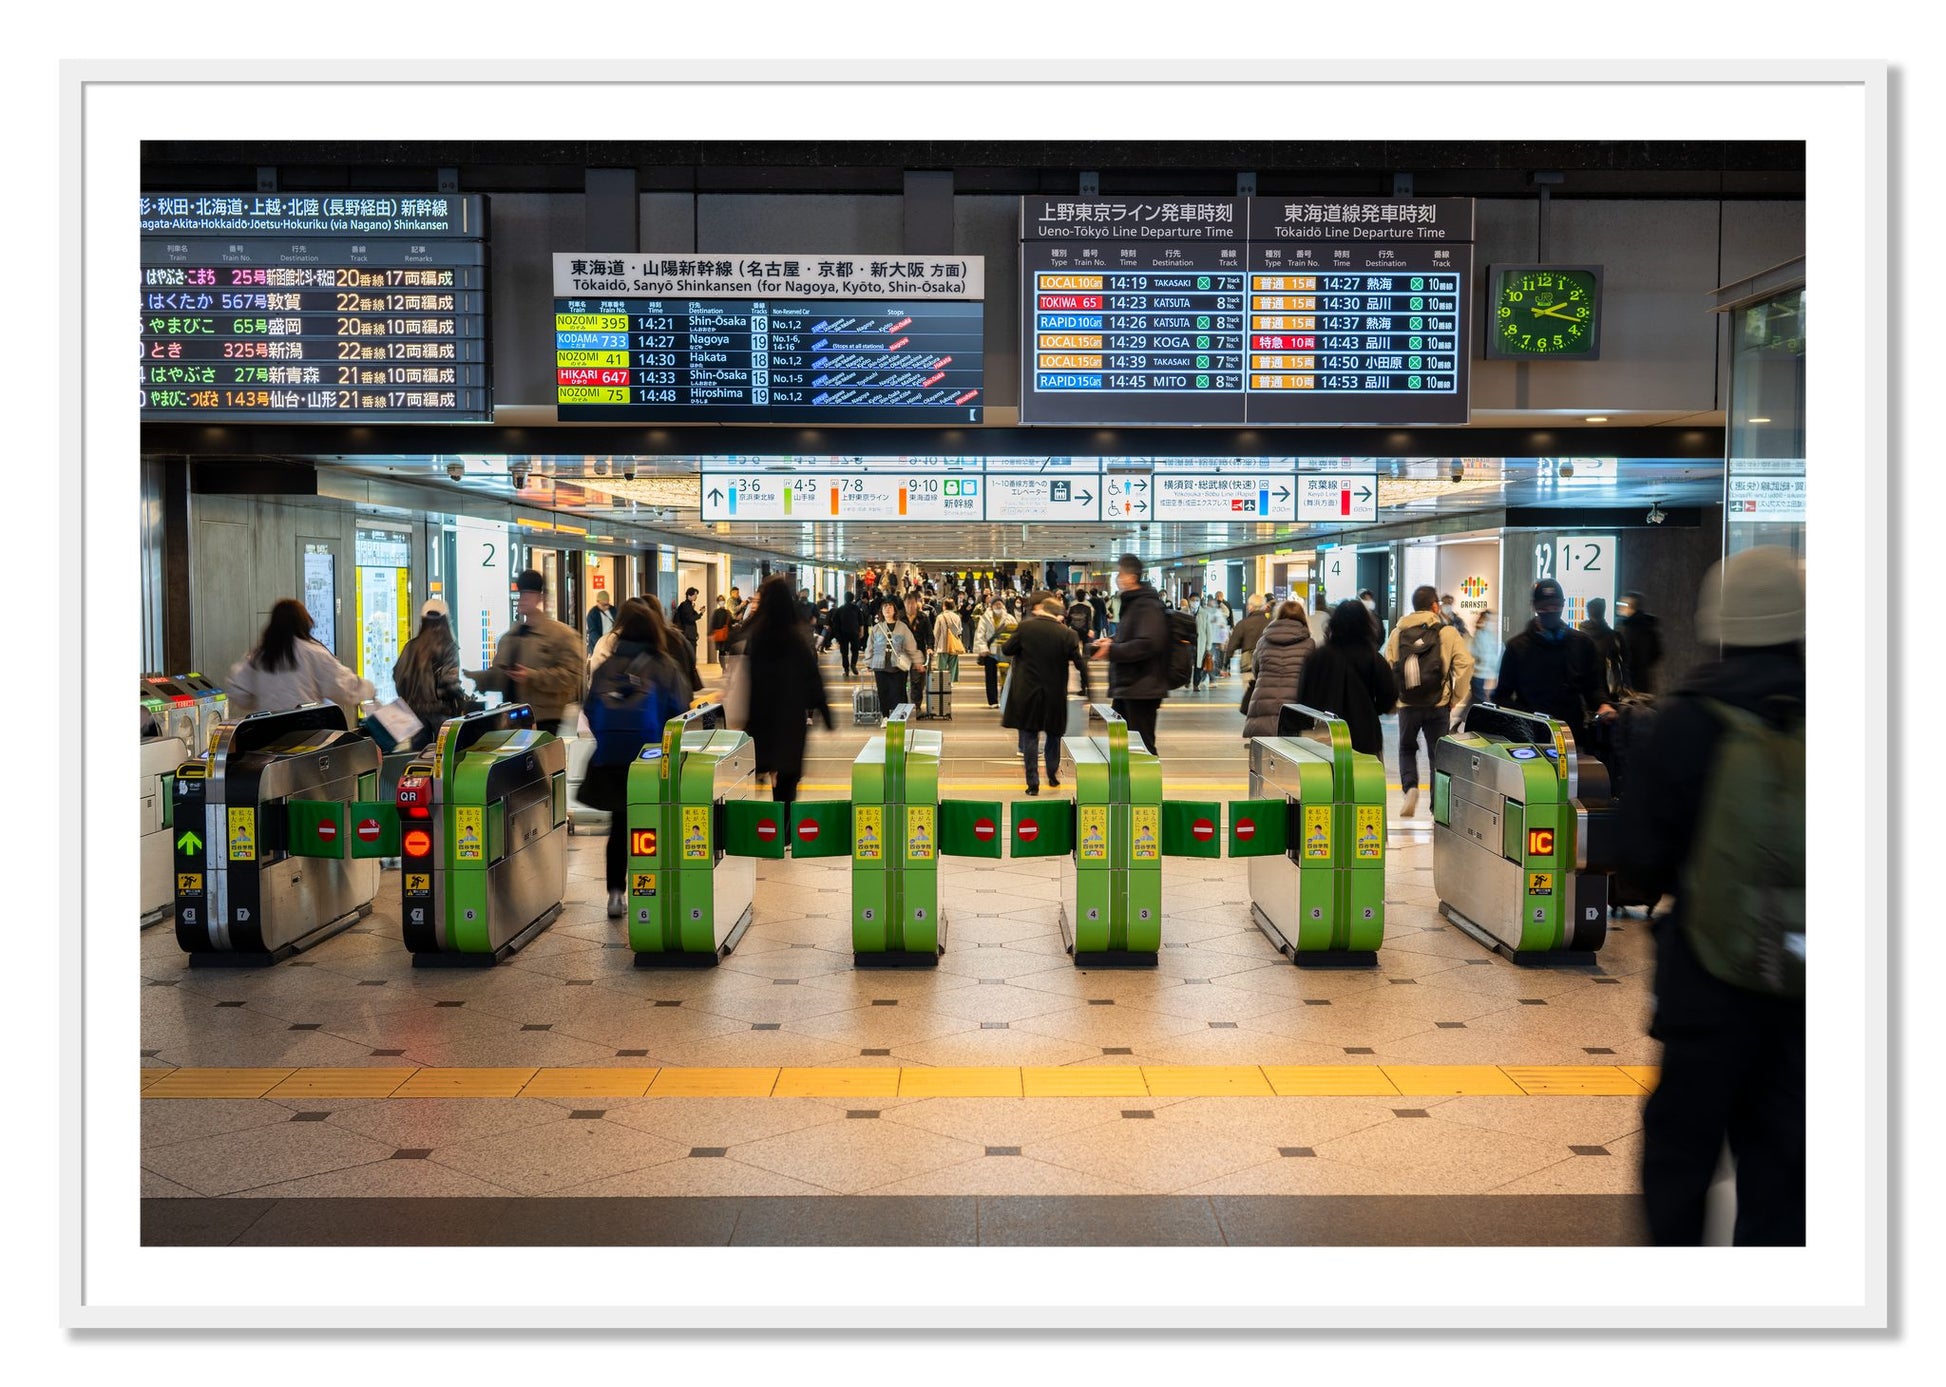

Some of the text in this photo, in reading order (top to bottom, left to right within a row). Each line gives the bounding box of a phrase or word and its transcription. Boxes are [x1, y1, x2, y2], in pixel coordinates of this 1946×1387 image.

[1038, 203, 1233, 222] 上野東京ライン発車時刻
[1284, 204, 1436, 223] 東海道線発車時刻
[330, 219, 348, 231] (via
[350, 219, 392, 231] Nagano)
[393, 219, 448, 231] Shinkansen
[1038, 225, 1234, 238] Ueno-Tōkyō Line Departure Time
[1275, 226, 1446, 239] Tōkaidō Line Departure Time
[280, 254, 318, 262] Destination
[350, 254, 368, 262] Track
[232, 268, 266, 286] 25号
[336, 268, 385, 286] 20番線
[1040, 277, 1191, 289] LOCAL 14:19 TAKASAKI
[1537, 277, 1552, 286] 12
[573, 278, 966, 295] Tōkaidō, Sanyō Shinkansen (for Nagoya, Kyōto, Shin-Ōsaka)
[1260, 278, 1392, 290] 普通 14:27 熱海
[1523, 281, 1535, 291] 11
[1558, 280, 1564, 290] 1
[1508, 291, 1523, 302] 10
[1570, 290, 1580, 300] 2
[149, 293, 385, 310] はくたか 567号 敦賀 22番線
[1041, 297, 1190, 309] TOKIWA 65 14:23 KATSUTA
[1260, 297, 1392, 310] 普通 14:30 品川
[1500, 308, 1511, 318] 9
[1576, 308, 1585, 318] 3
[149, 318, 301, 335] やまびこ 65号 盛岡
[558, 315, 766, 330] NOZOMI 395 14:21 Shin-Ōsaka 16
[772, 320, 802, 330] No.1,2
[1041, 316, 1190, 329] RAPID 14:26 KATSUTA
[1322, 317, 1392, 329] 14:37 熱海
[1508, 324, 1517, 335] 8
[1568, 325, 1578, 334] 4
[558, 334, 767, 348] KODAMA 733 14:27 Nagoya 19
[772, 335, 800, 344] No.1-6,
[1110, 336, 1190, 348] 14:29 KOGA
[1259, 337, 1390, 349] 特急 14:43 品川
[1522, 335, 1531, 345] 7
[1537, 338, 1547, 348] 6
[1553, 335, 1562, 345] 5
[152, 342, 303, 359] とき 325号 新潟
[558, 352, 767, 366] NOZOMI 41 14:30 Hakata 18
[1109, 356, 1190, 368] 14:39 TAKASAKI
[1322, 357, 1403, 369] 14:50 小田原
[152, 366, 386, 383] はやぶさ 27号 新青森 21番線
[560, 369, 767, 385] HIKARI 647 14:33 Shin-Ōsaka 15
[1109, 376, 1186, 388] 14:45 MITO
[1321, 376, 1390, 388] 14:53 品川
[226, 390, 269, 408] 143号
[270, 390, 336, 408] 仙台・山形
[559, 388, 767, 403] NOZOMI 75 14:48 Hiroshima 19
[738, 479, 938, 492] 3·6 4·5 7·8 9·10
[1307, 480, 1338, 490] 京葉線
[1011, 488, 1048, 496] エレベーター
[739, 493, 775, 501] 京浜東北線
[794, 493, 816, 501] 山手線
[841, 493, 889, 501] 上野東京ライン
[944, 498, 974, 509] 新幹線
[432, 535, 439, 577] 1
[482, 543, 496, 567] 2
[1563, 543, 1601, 571] 1·2
[1331, 560, 1341, 576] 4
[1389, 554, 1396, 582] 3
[400, 791, 417, 801] QR
[633, 832, 656, 854] IC
[1530, 832, 1553, 853] IC
[415, 910, 421, 919] 7
[640, 910, 647, 919] 6
[865, 909, 872, 919] 5
[1089, 909, 1097, 919] 4
[1313, 909, 1320, 918] 3
[1536, 909, 1543, 918] 2
